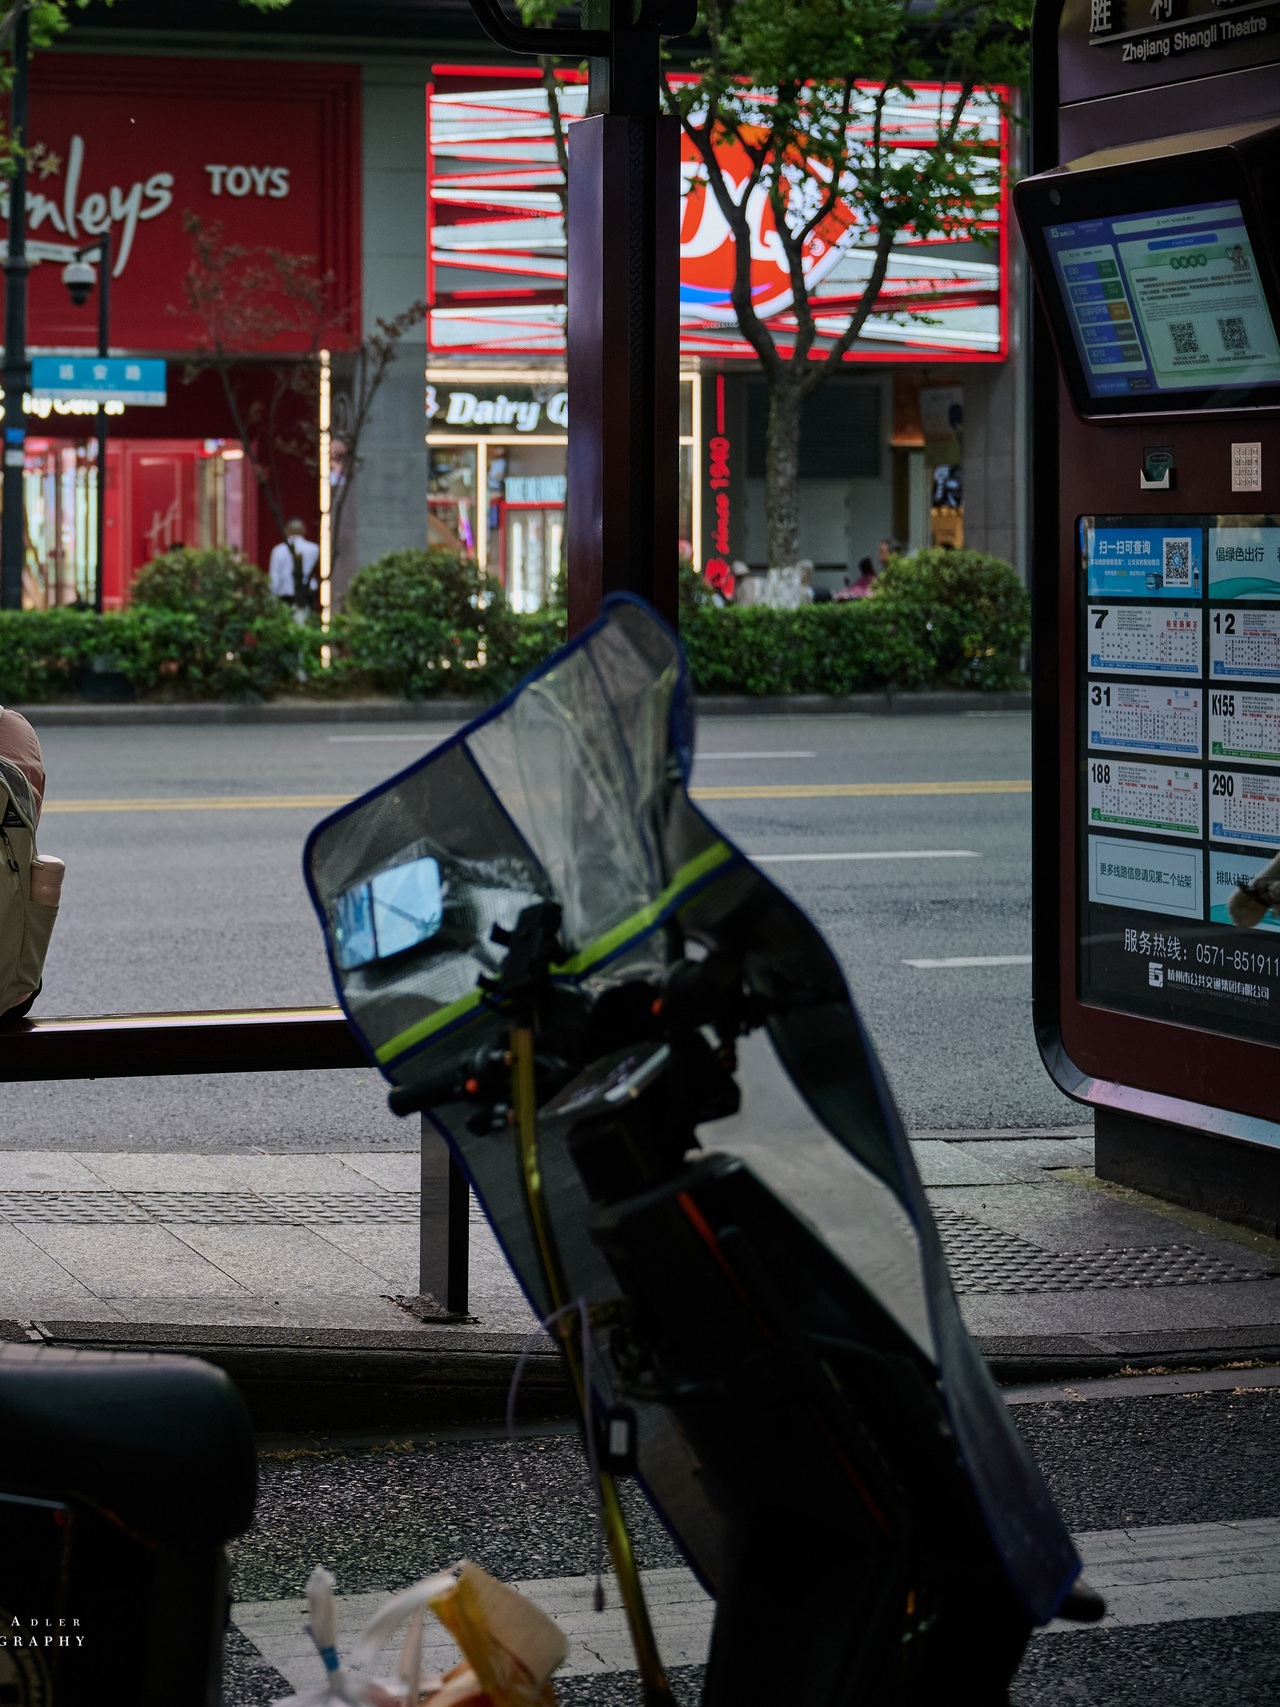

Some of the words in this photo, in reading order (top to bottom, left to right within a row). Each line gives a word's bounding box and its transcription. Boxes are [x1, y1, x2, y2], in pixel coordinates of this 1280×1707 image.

[1122, 38, 1170, 62] Zhejiang
[1174, 24, 1217, 50] Shengli
[1220, 16, 1267, 40] Theatre
[205, 165, 290, 199] TOYS
[446, 392, 541, 432] Dairy
[1099, 540, 1151, 554] 扫一扫可查询
[1215, 546, 1265, 562] 倡绿色出行
[1091, 610, 1109, 629] 7
[1213, 613, 1236, 635] 12
[1091, 686, 1111, 707] 31
[1211, 694, 1235, 717] K155
[1091, 763, 1111, 785] 188
[1212, 774, 1234, 797] 290
[1100, 862, 1192, 889] 更多线路信息请见第二个站架
[1167, 968, 1271, 1000] 杭州市公共交通集团有限公司
